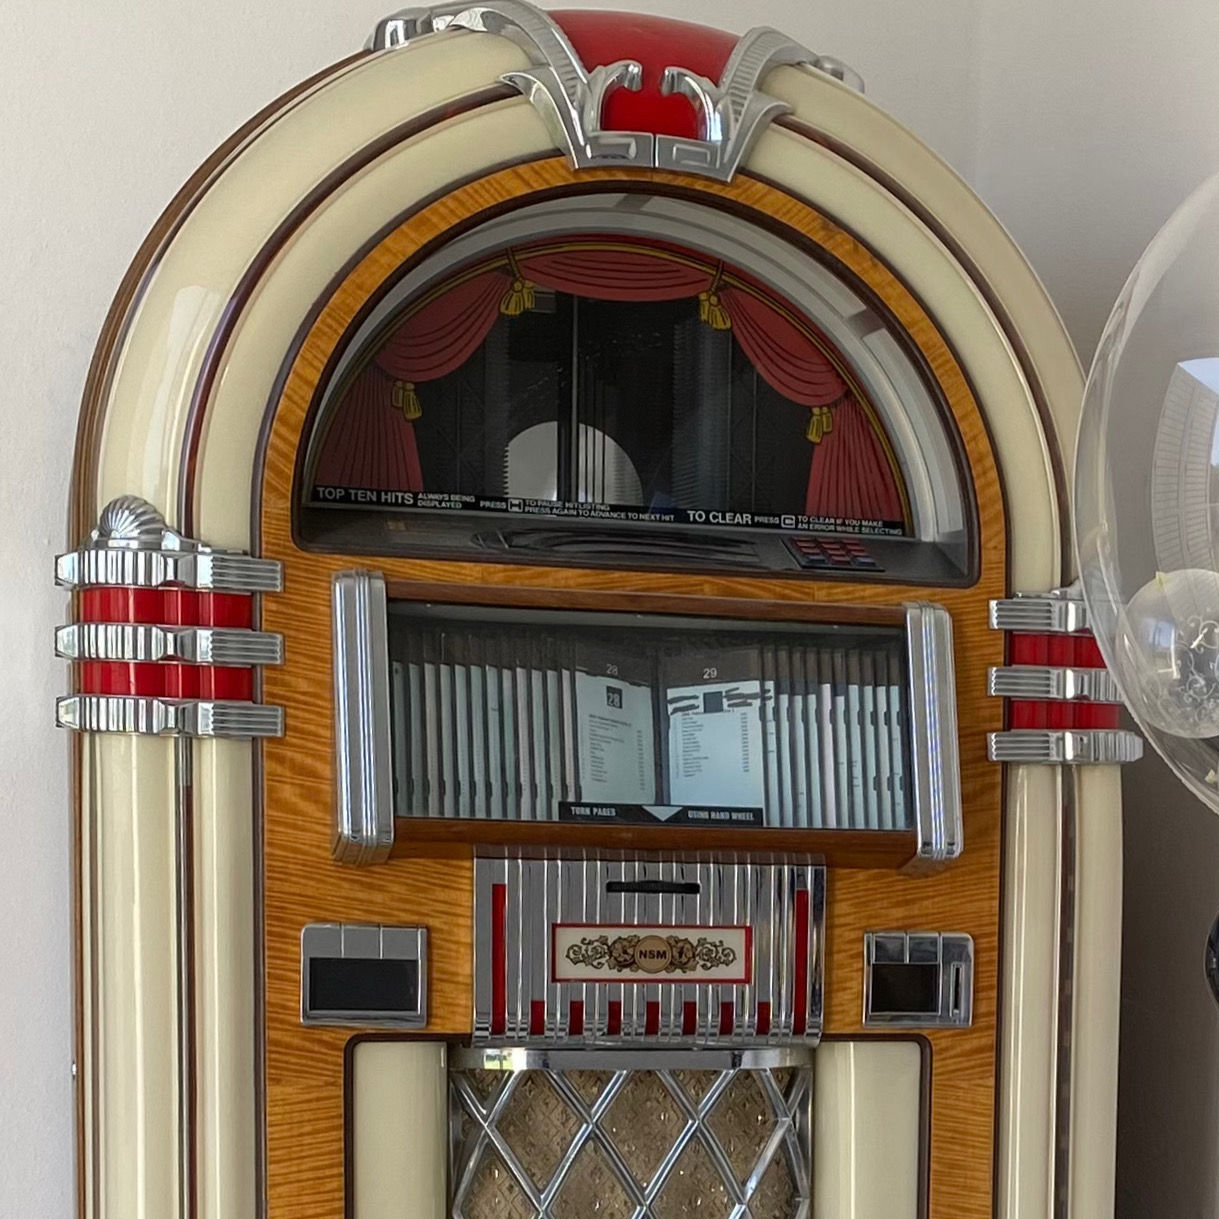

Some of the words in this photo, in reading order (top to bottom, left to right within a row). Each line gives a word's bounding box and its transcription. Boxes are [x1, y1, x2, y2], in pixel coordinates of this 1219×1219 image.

[317, 487, 345, 500] TOP
[350, 489, 377, 502] TEN
[381, 491, 414, 505] HITS
[417, 492, 449, 501] ALWAYS
[451, 494, 476, 503] BEING
[417, 500, 463, 509] DISPLAYED
[480, 500, 506, 509] PRESS
[525, 499, 537, 507] TO
[538, 500, 563, 508] PAUSE
[525, 506, 551, 514] PRESS
[552, 507, 577, 516] AGAIN
[579, 509, 589, 517] TO
[590, 510, 626, 519] ADVANCE
[627, 512, 638, 520] TO
[639, 513, 660, 521] NEXT
[661, 514, 675, 522] HIT
[687, 510, 706, 522] TO
[709, 512, 752, 525] CLEAR
[754, 515, 780, 525] PRESS
[798, 515, 809, 523] TO
[809, 516, 835, 525] CLEAR
[845, 518, 860, 526] YOU
[862, 519, 884, 528] MAKE
[797, 522, 809, 530] AN
[809, 523, 835, 532] ERROR
[836, 525, 860, 533] WHILE
[861, 526, 903, 536] SELECTING
[703, 668, 718, 679] 29
[607, 692, 621, 708] 28
[571, 806, 591, 816] TURN
[593, 807, 616, 817] PAGES
[688, 810, 709, 820] USING
[711, 811, 730, 820] HAND
[732, 812, 755, 821] WHEEL
[639, 949, 668, 960] NSM
